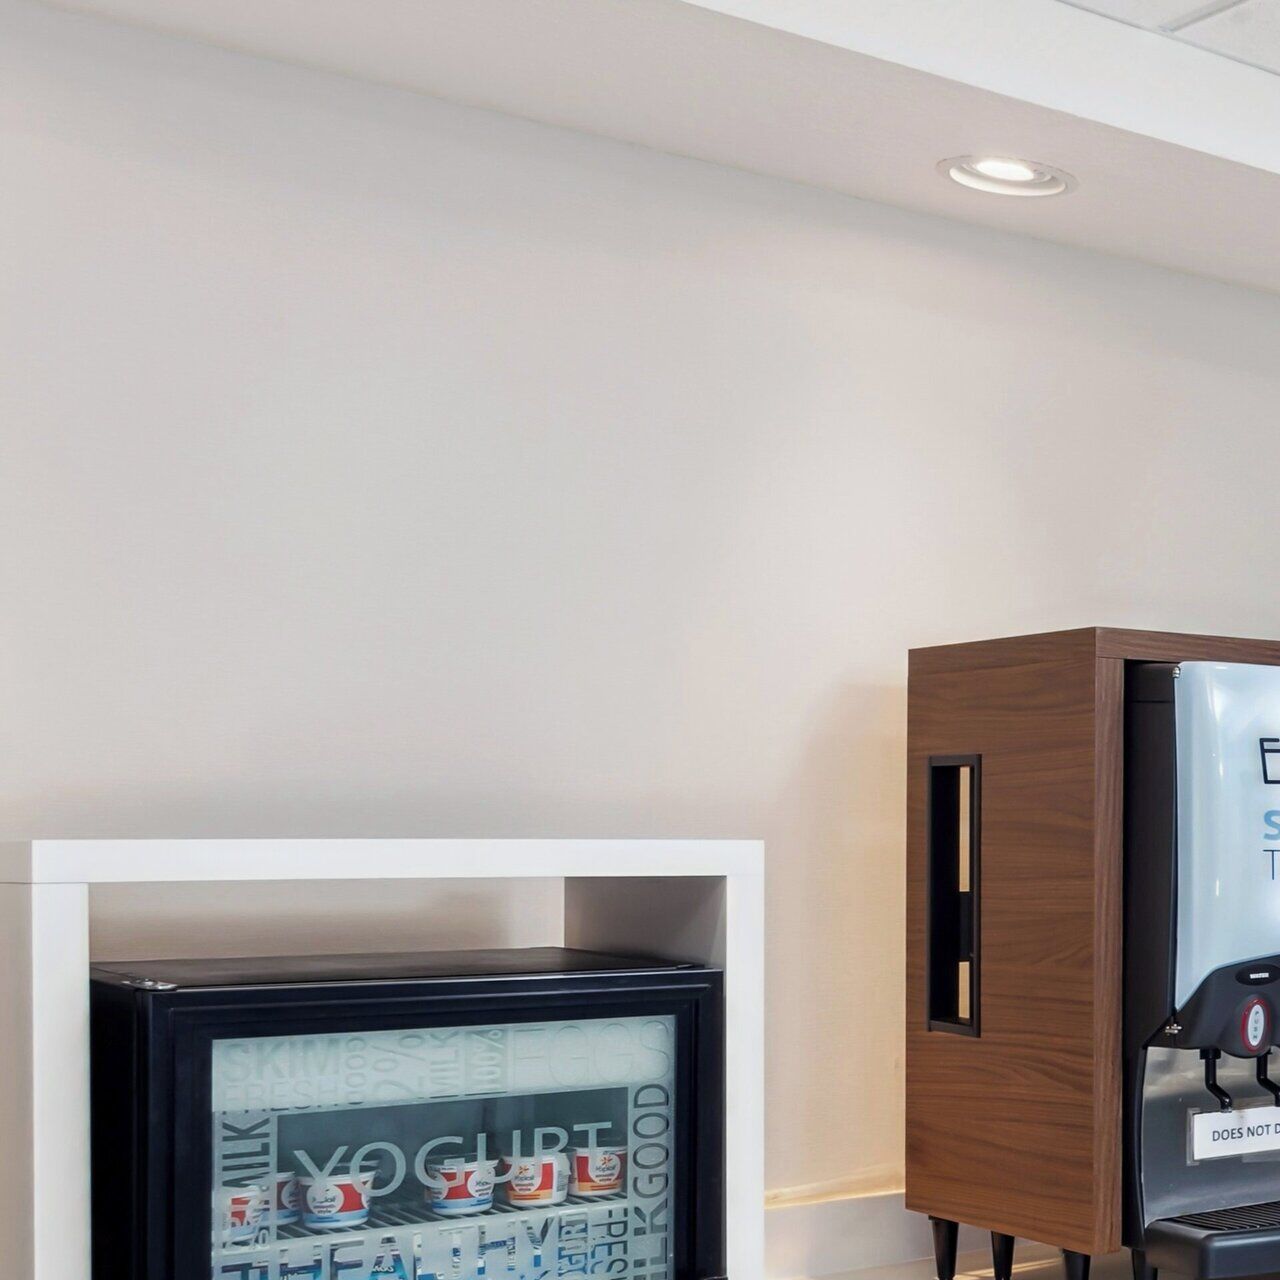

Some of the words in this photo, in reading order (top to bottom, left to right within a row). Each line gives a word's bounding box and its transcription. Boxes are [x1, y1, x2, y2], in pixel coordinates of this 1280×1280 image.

[293, 1120, 612, 1198] YOGURT
[633, 1083, 669, 1198] GOOD
[1211, 1126, 1244, 1142] DOES
[1246, 1123, 1272, 1138] NOT
